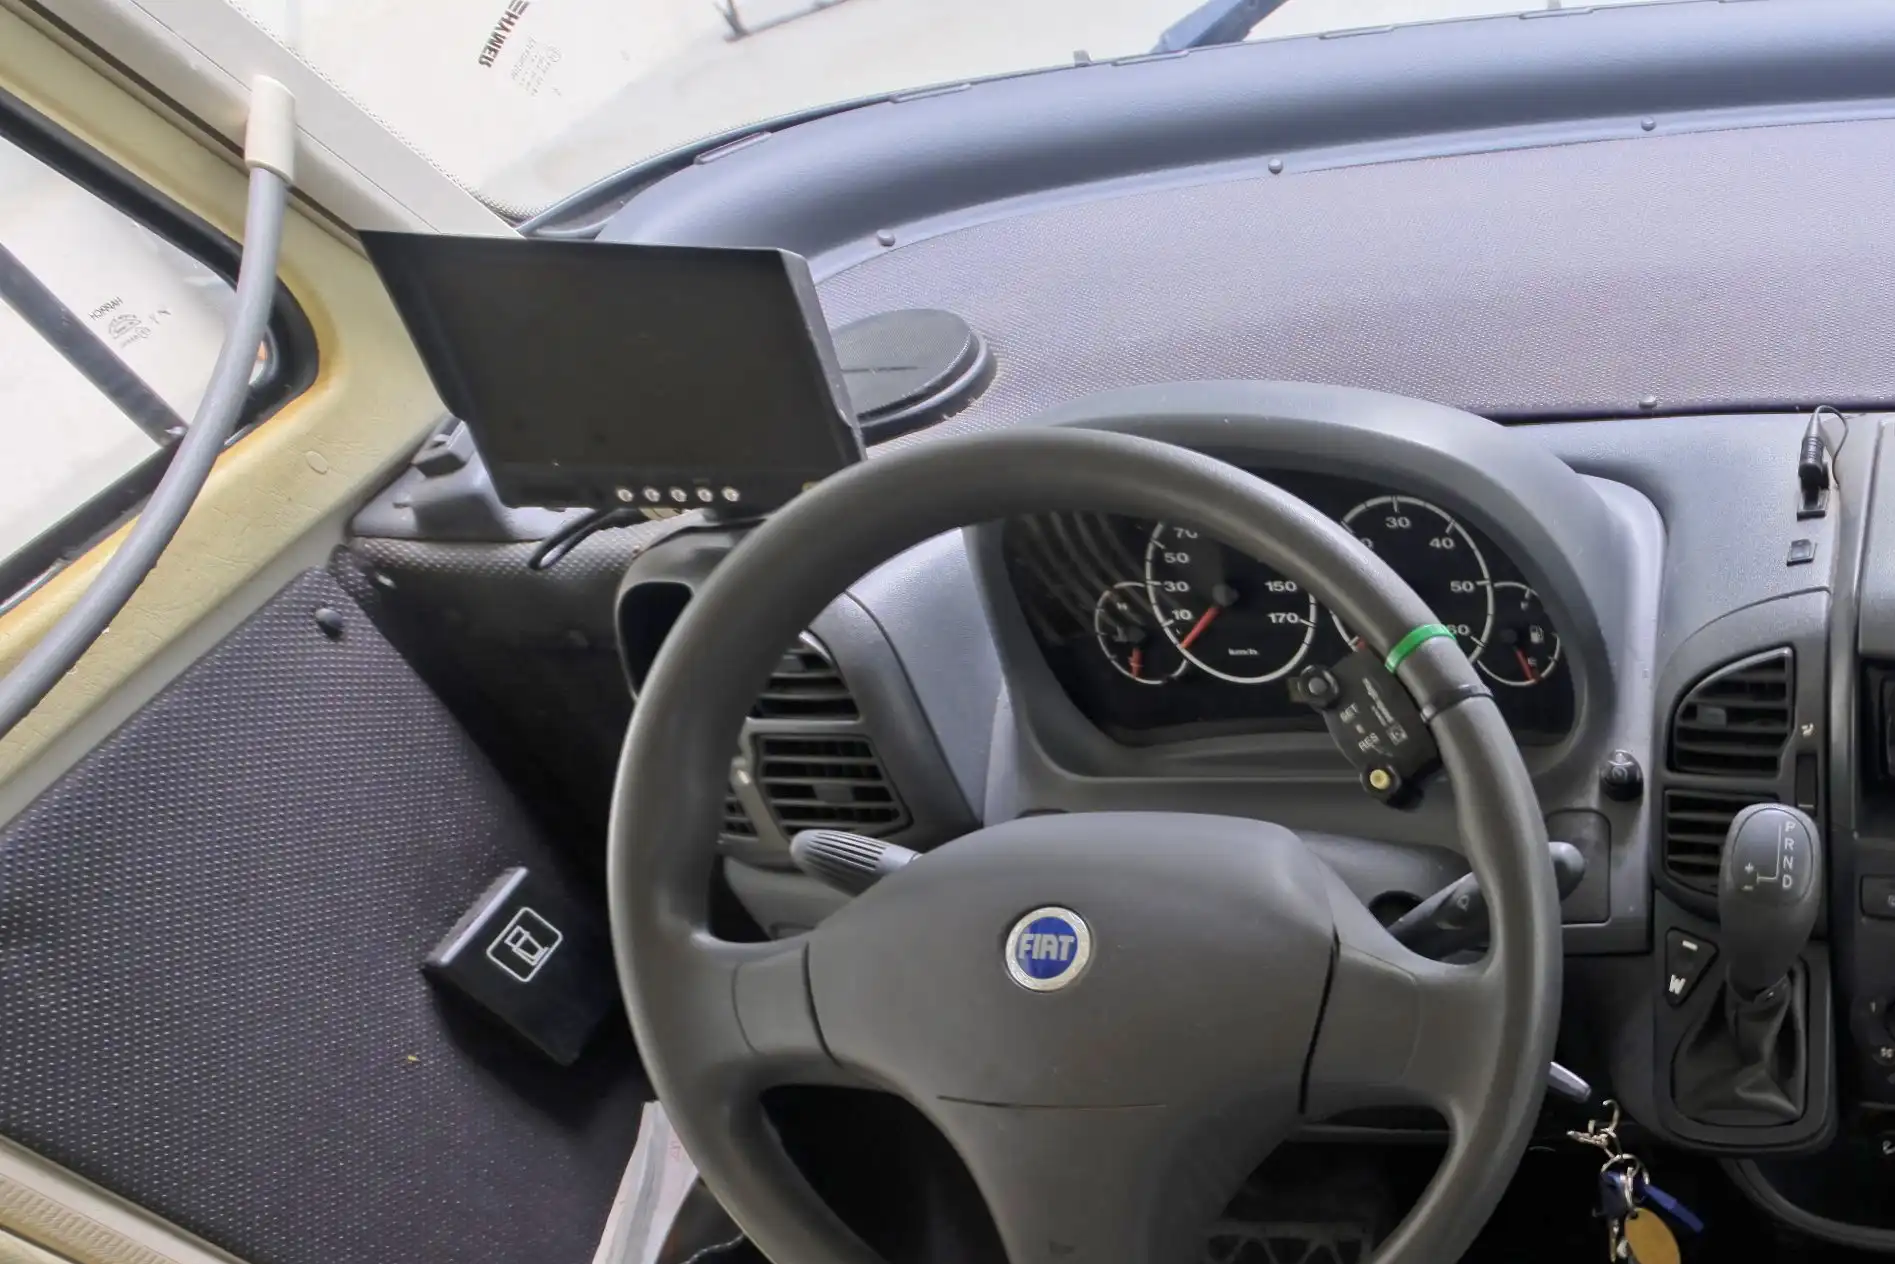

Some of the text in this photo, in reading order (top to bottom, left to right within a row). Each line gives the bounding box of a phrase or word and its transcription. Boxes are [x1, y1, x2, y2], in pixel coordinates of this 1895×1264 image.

[1385, 516, 1411, 529] 30
[1429, 537, 1455, 549] 40
[1164, 552, 1190, 563] 50
[1164, 581, 1190, 592] 30
[1264, 580, 1298, 592] 150
[1450, 580, 1476, 593] 50
[1171, 609, 1193, 621] 10
[1268, 612, 1299, 624] 170
[1358, 732, 1380, 752] RES
[1785, 821, 1796, 833] P
[1784, 837, 1795, 850] R
[1783, 855, 1794, 870] N
[1782, 874, 1793, 888] D
[1018, 932, 1077, 962] FIAT
[1668, 974, 1686, 995] W
